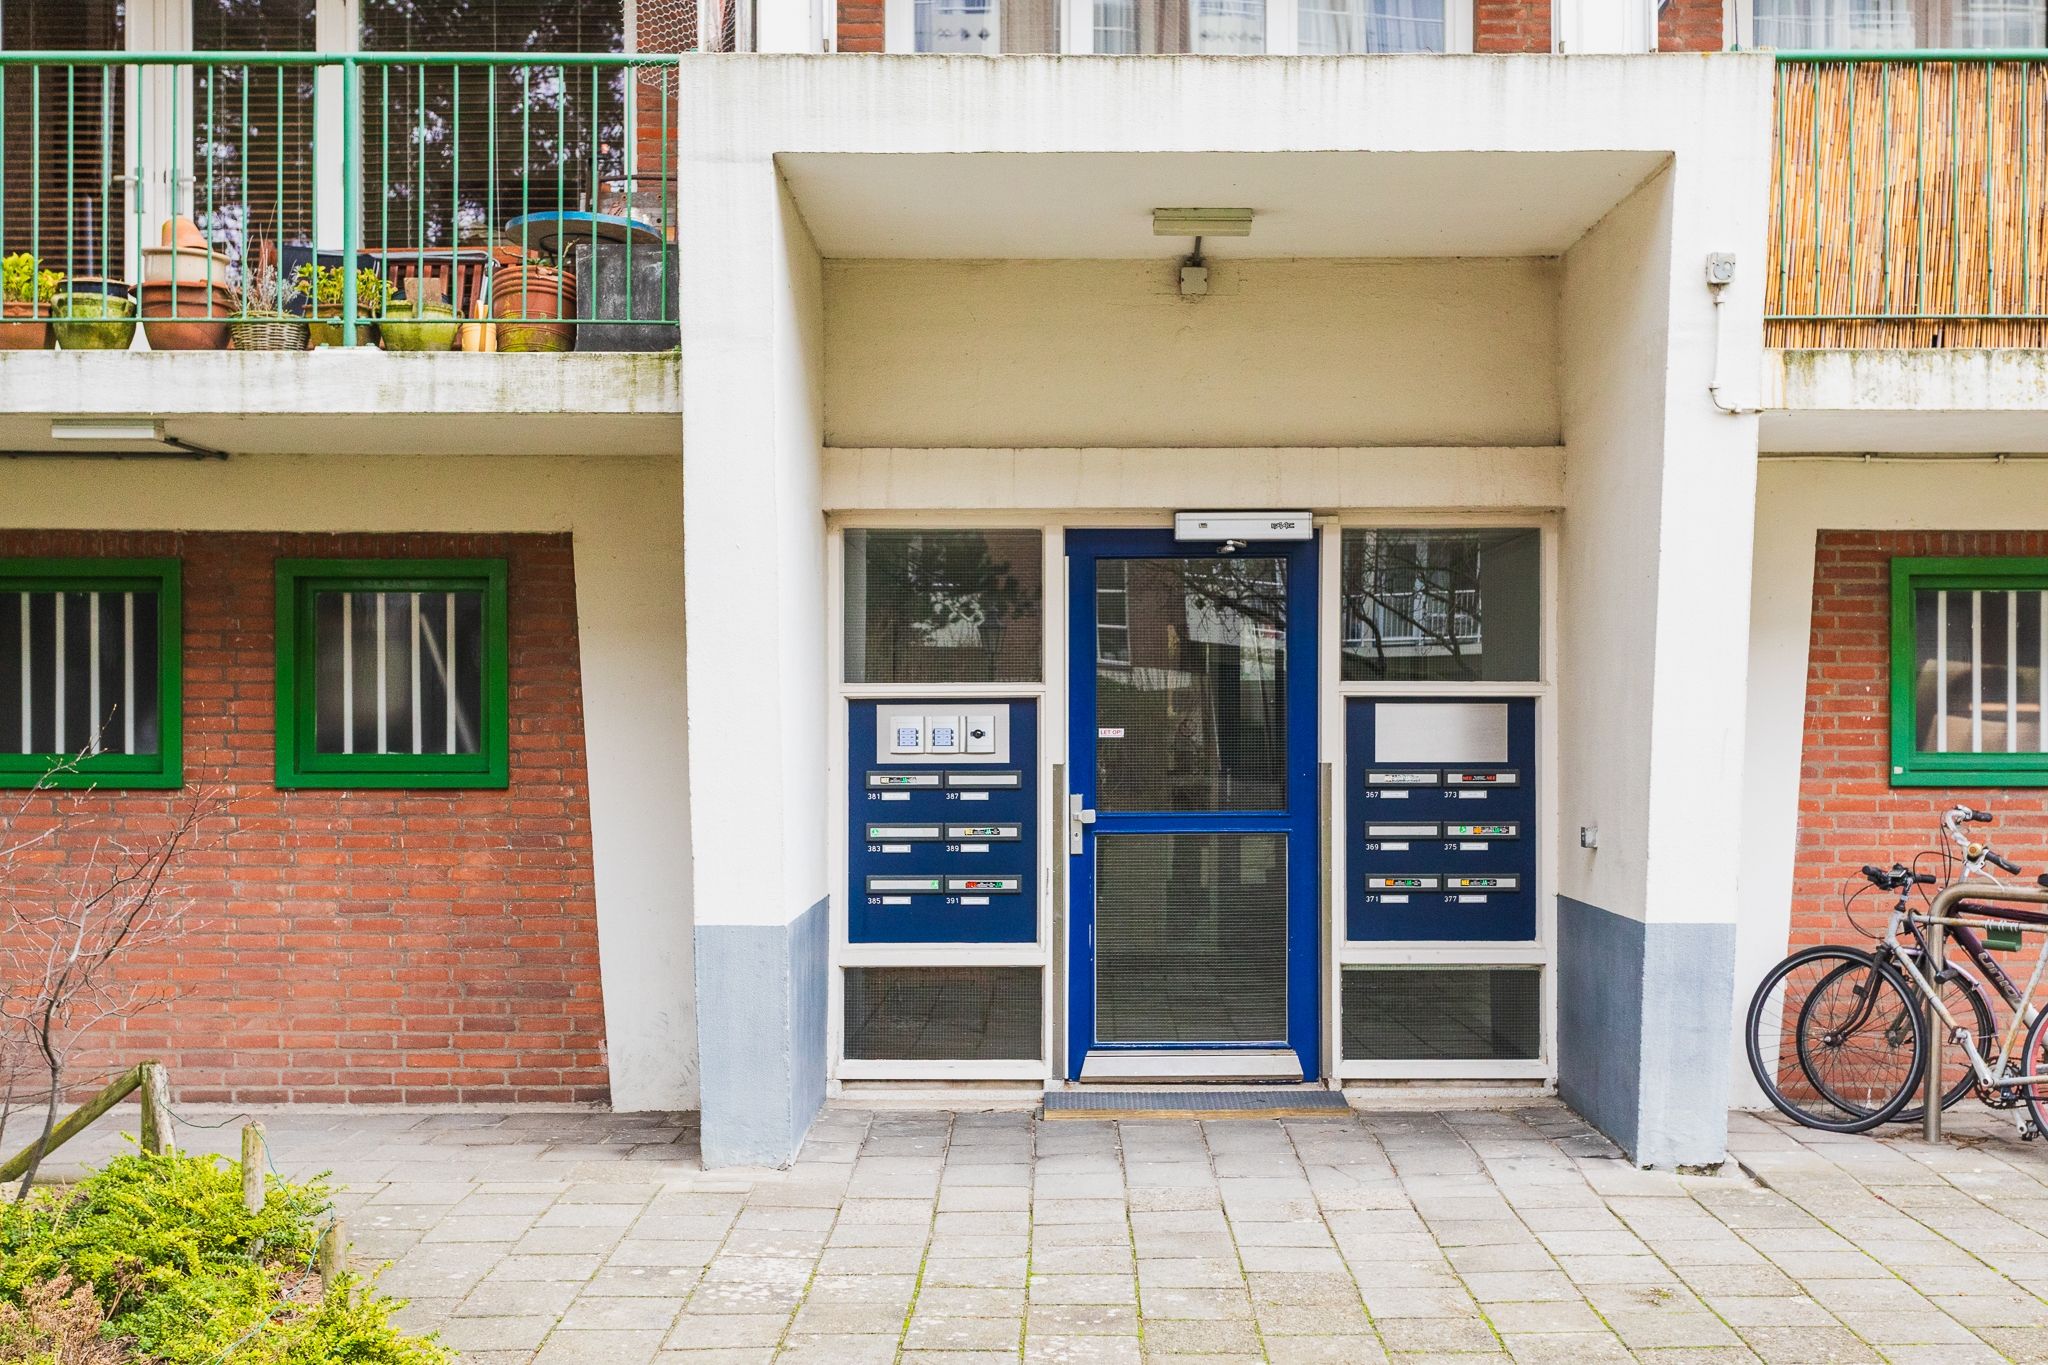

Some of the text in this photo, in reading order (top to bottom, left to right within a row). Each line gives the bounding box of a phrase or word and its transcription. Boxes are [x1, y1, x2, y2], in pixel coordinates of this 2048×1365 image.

[867, 792, 880, 800] 381
[946, 792, 959, 800] 387
[1444, 791, 1457, 799] 373
